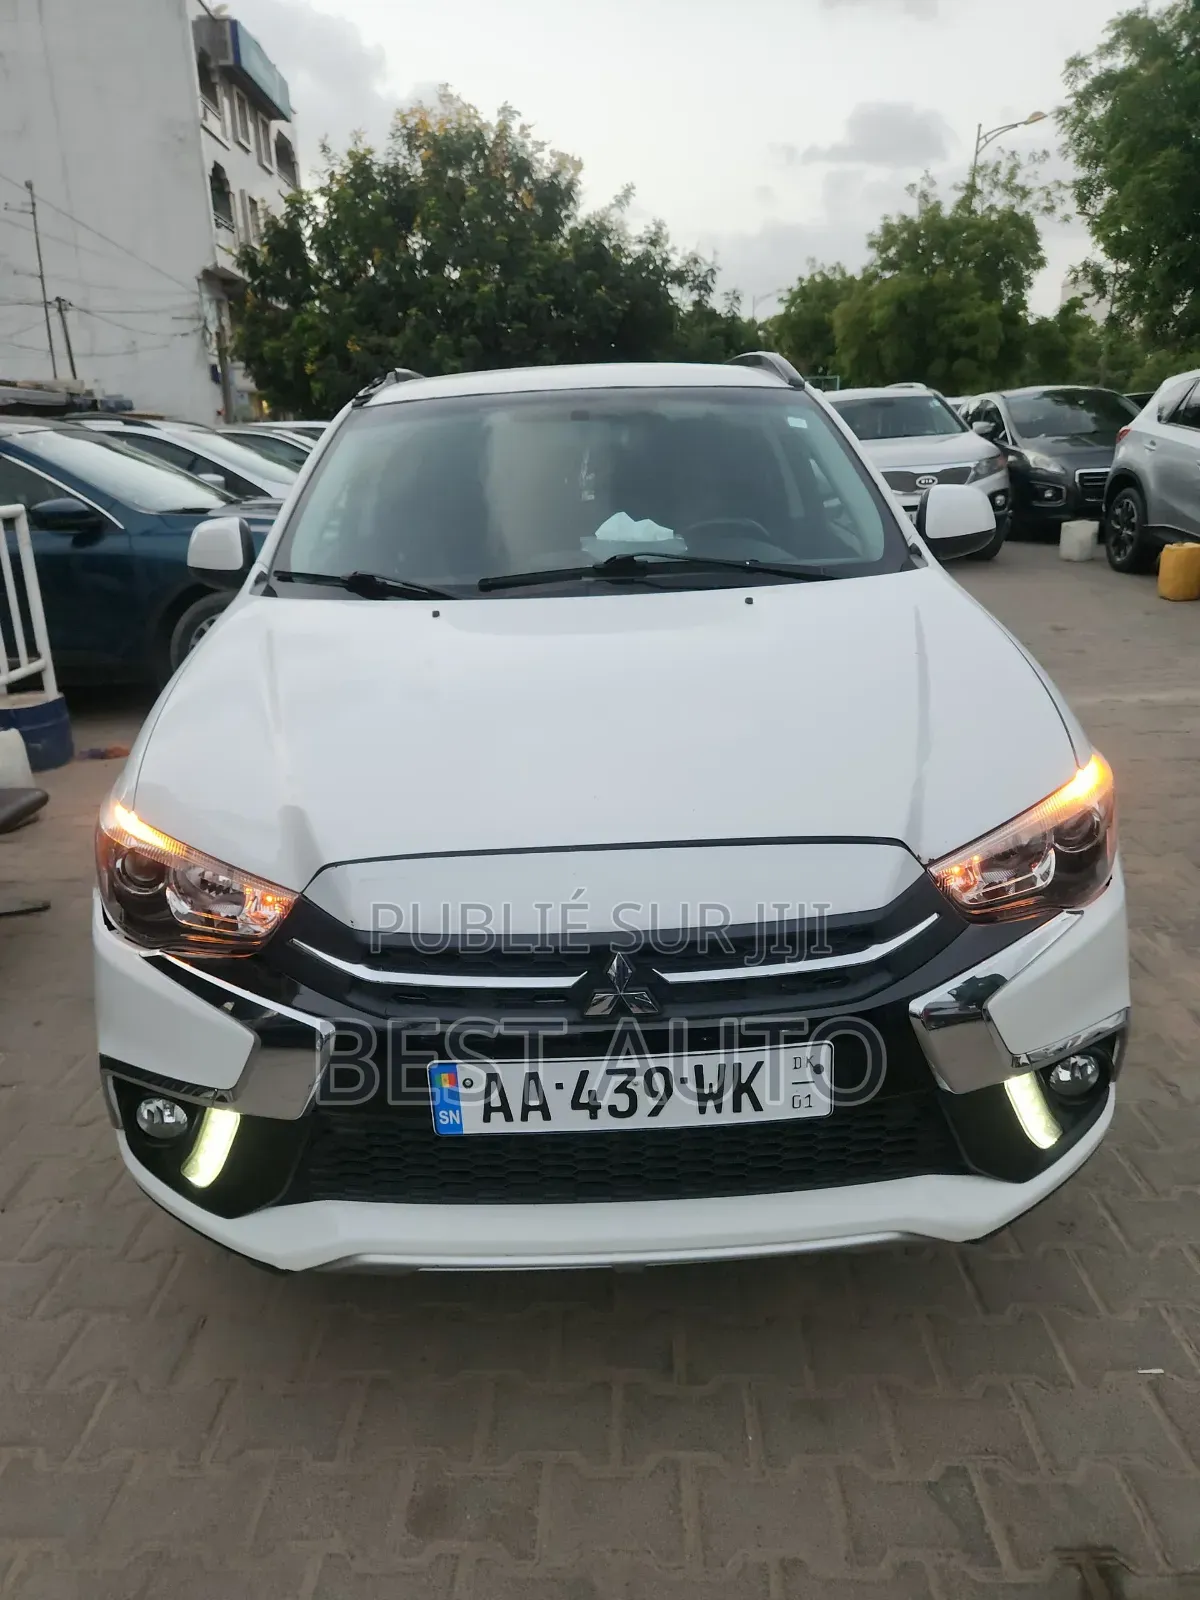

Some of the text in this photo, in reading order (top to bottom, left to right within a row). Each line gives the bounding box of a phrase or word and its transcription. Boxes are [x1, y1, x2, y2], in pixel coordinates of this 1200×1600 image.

[792, 1055, 816, 1071] DK
[791, 1093, 814, 1109] 01
[438, 1110, 461, 1125] SN
